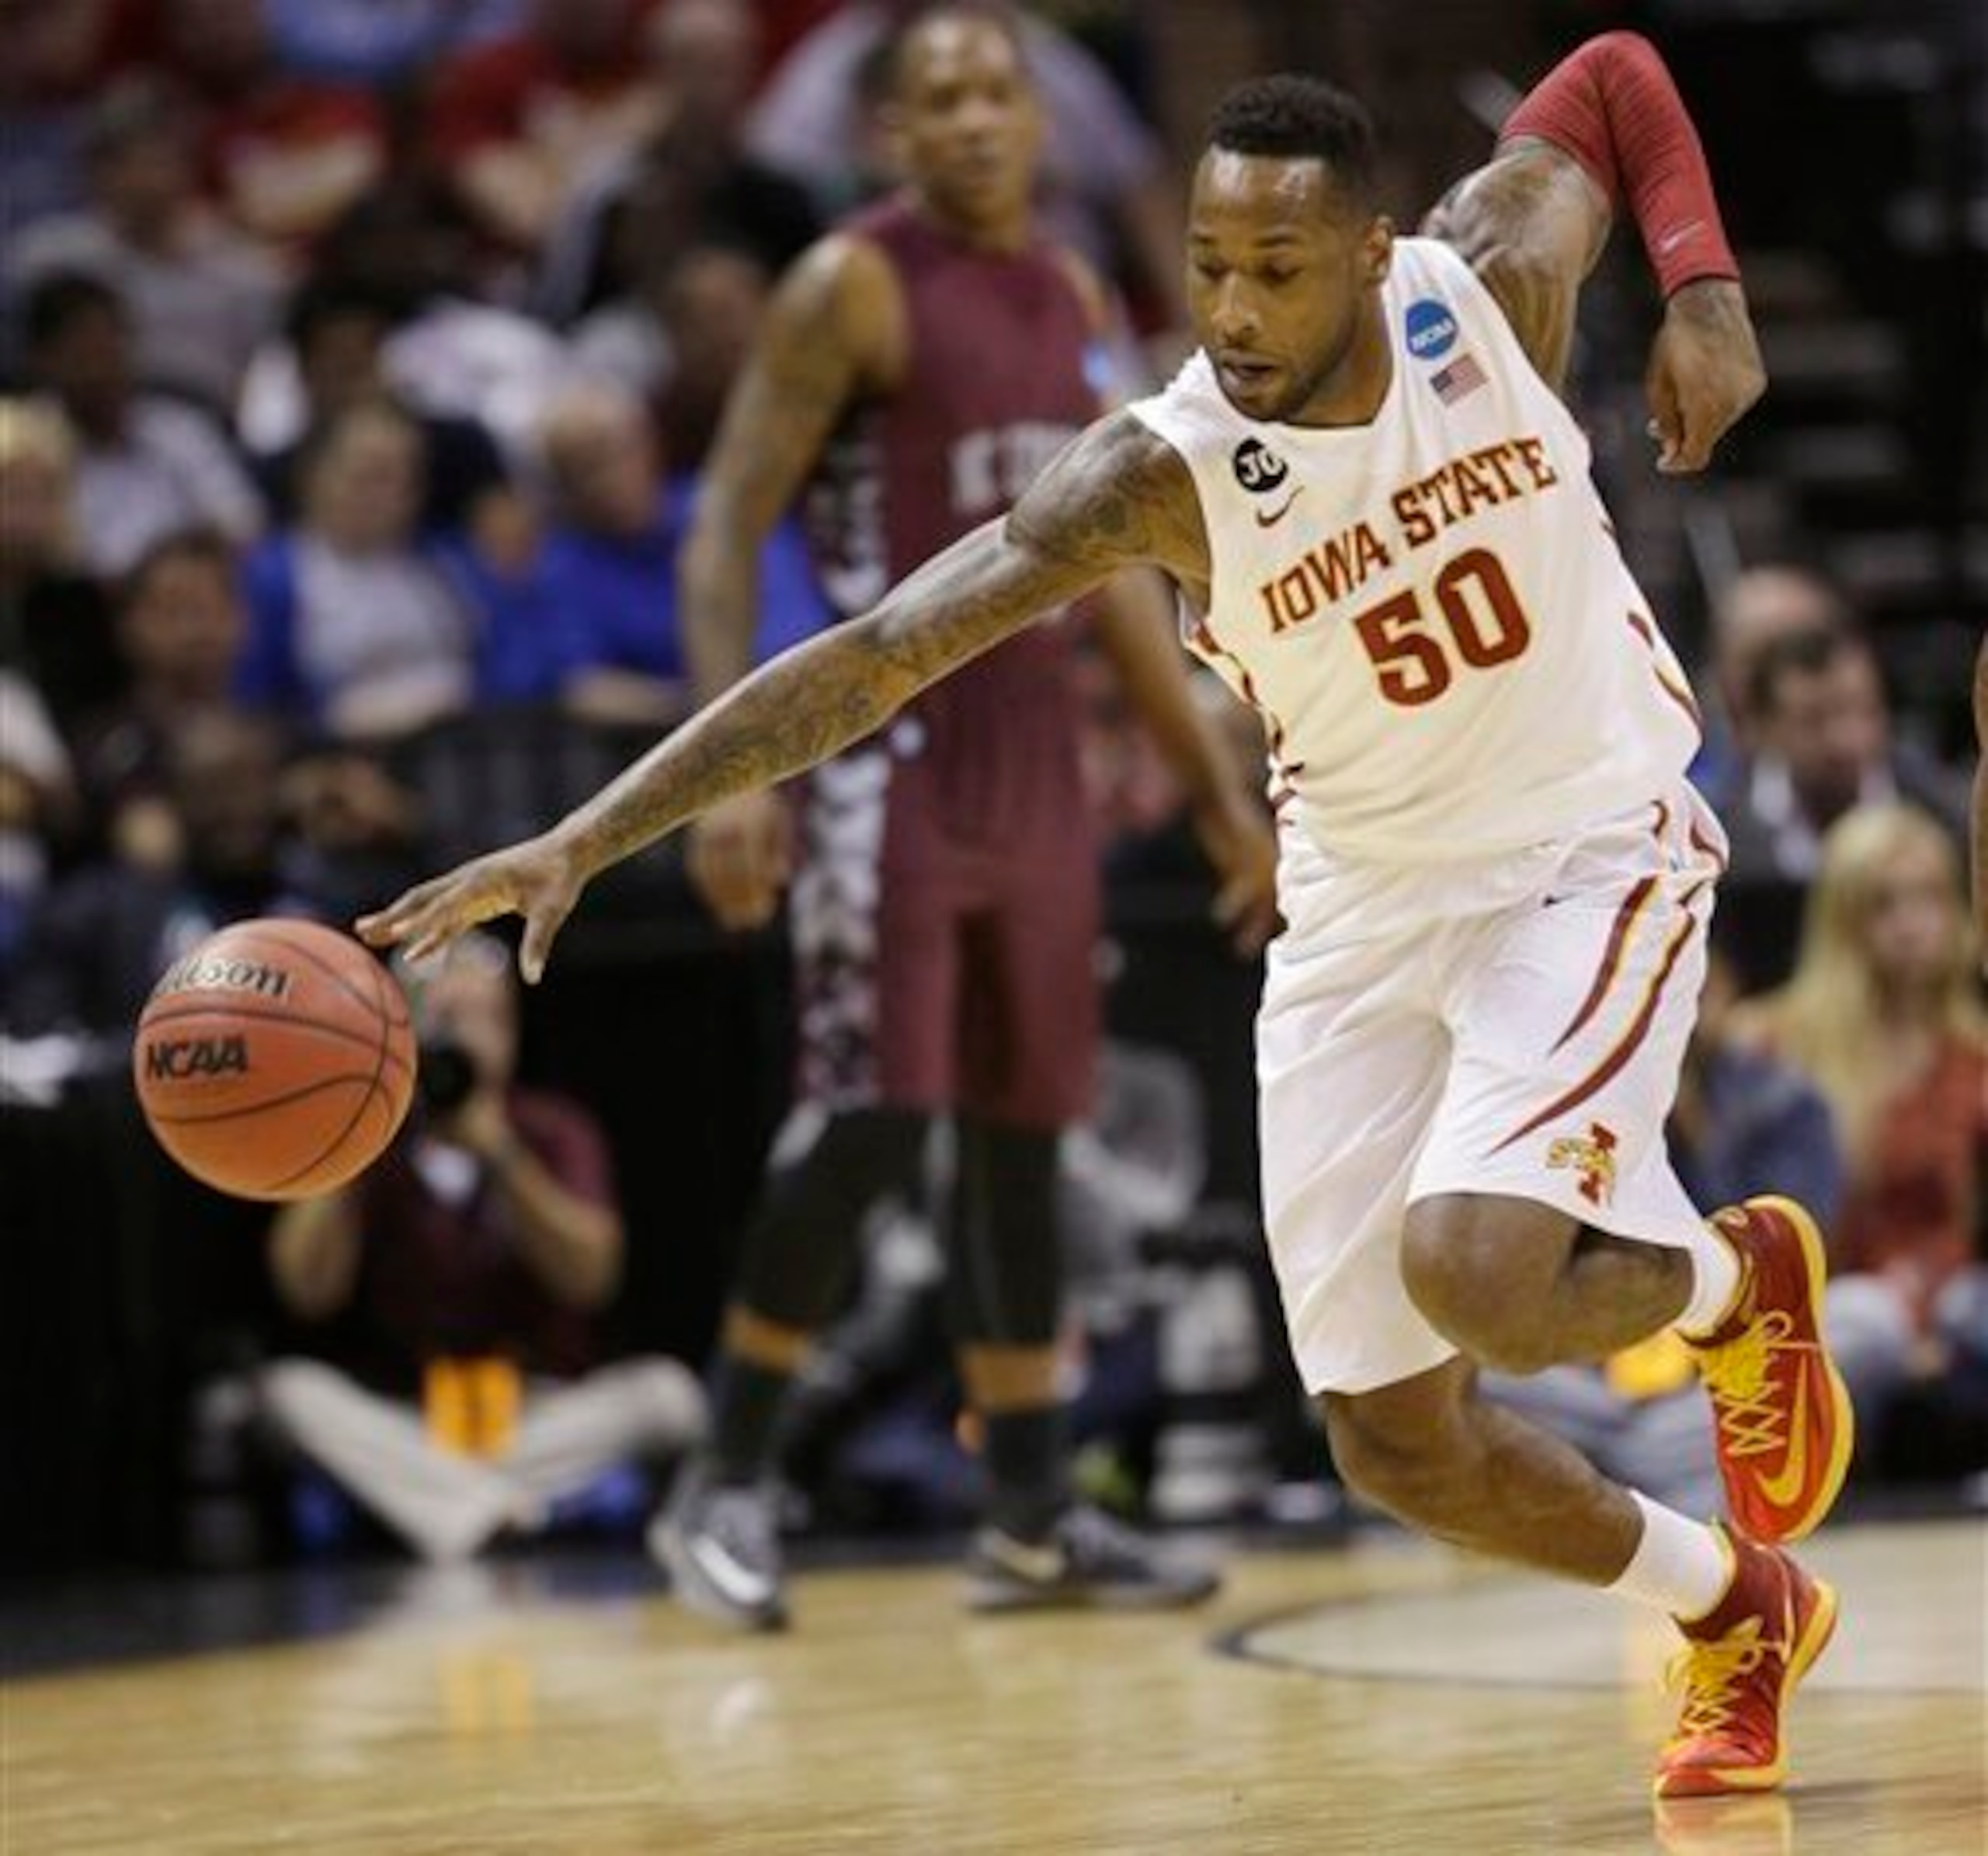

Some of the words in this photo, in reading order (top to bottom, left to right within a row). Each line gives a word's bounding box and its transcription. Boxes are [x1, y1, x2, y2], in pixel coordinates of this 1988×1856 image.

[1261, 523, 1391, 633] IOWA
[1392, 438, 1556, 548] STATE
[1354, 547, 1530, 706] 50
[146, 1036, 248, 1079] NCAA
